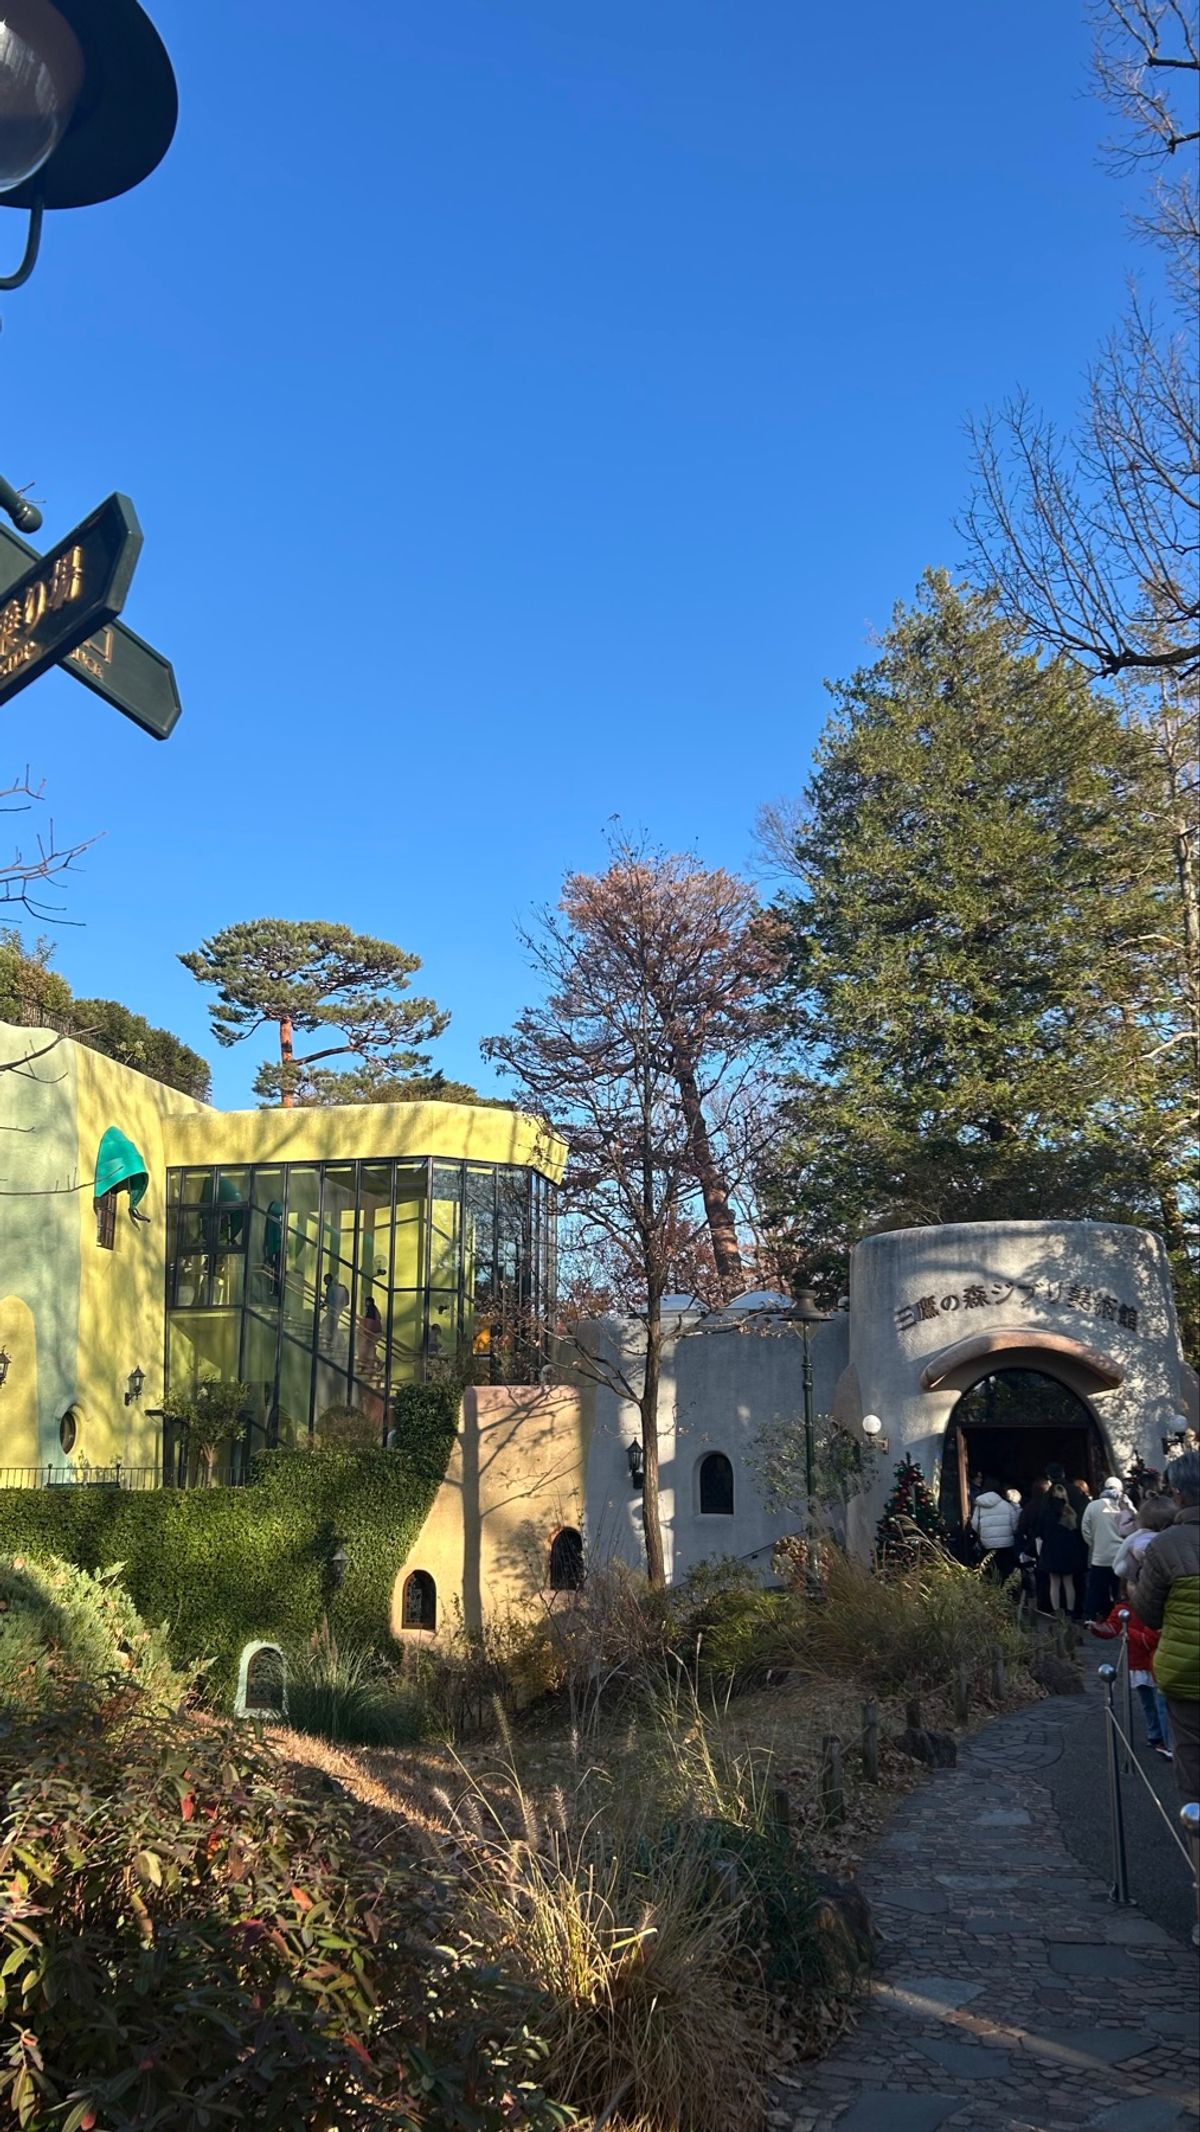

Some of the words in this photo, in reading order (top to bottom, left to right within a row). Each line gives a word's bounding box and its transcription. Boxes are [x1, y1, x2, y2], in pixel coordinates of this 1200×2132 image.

[896, 1282, 1138, 1332] 三鷹の森ジブリ美術館
